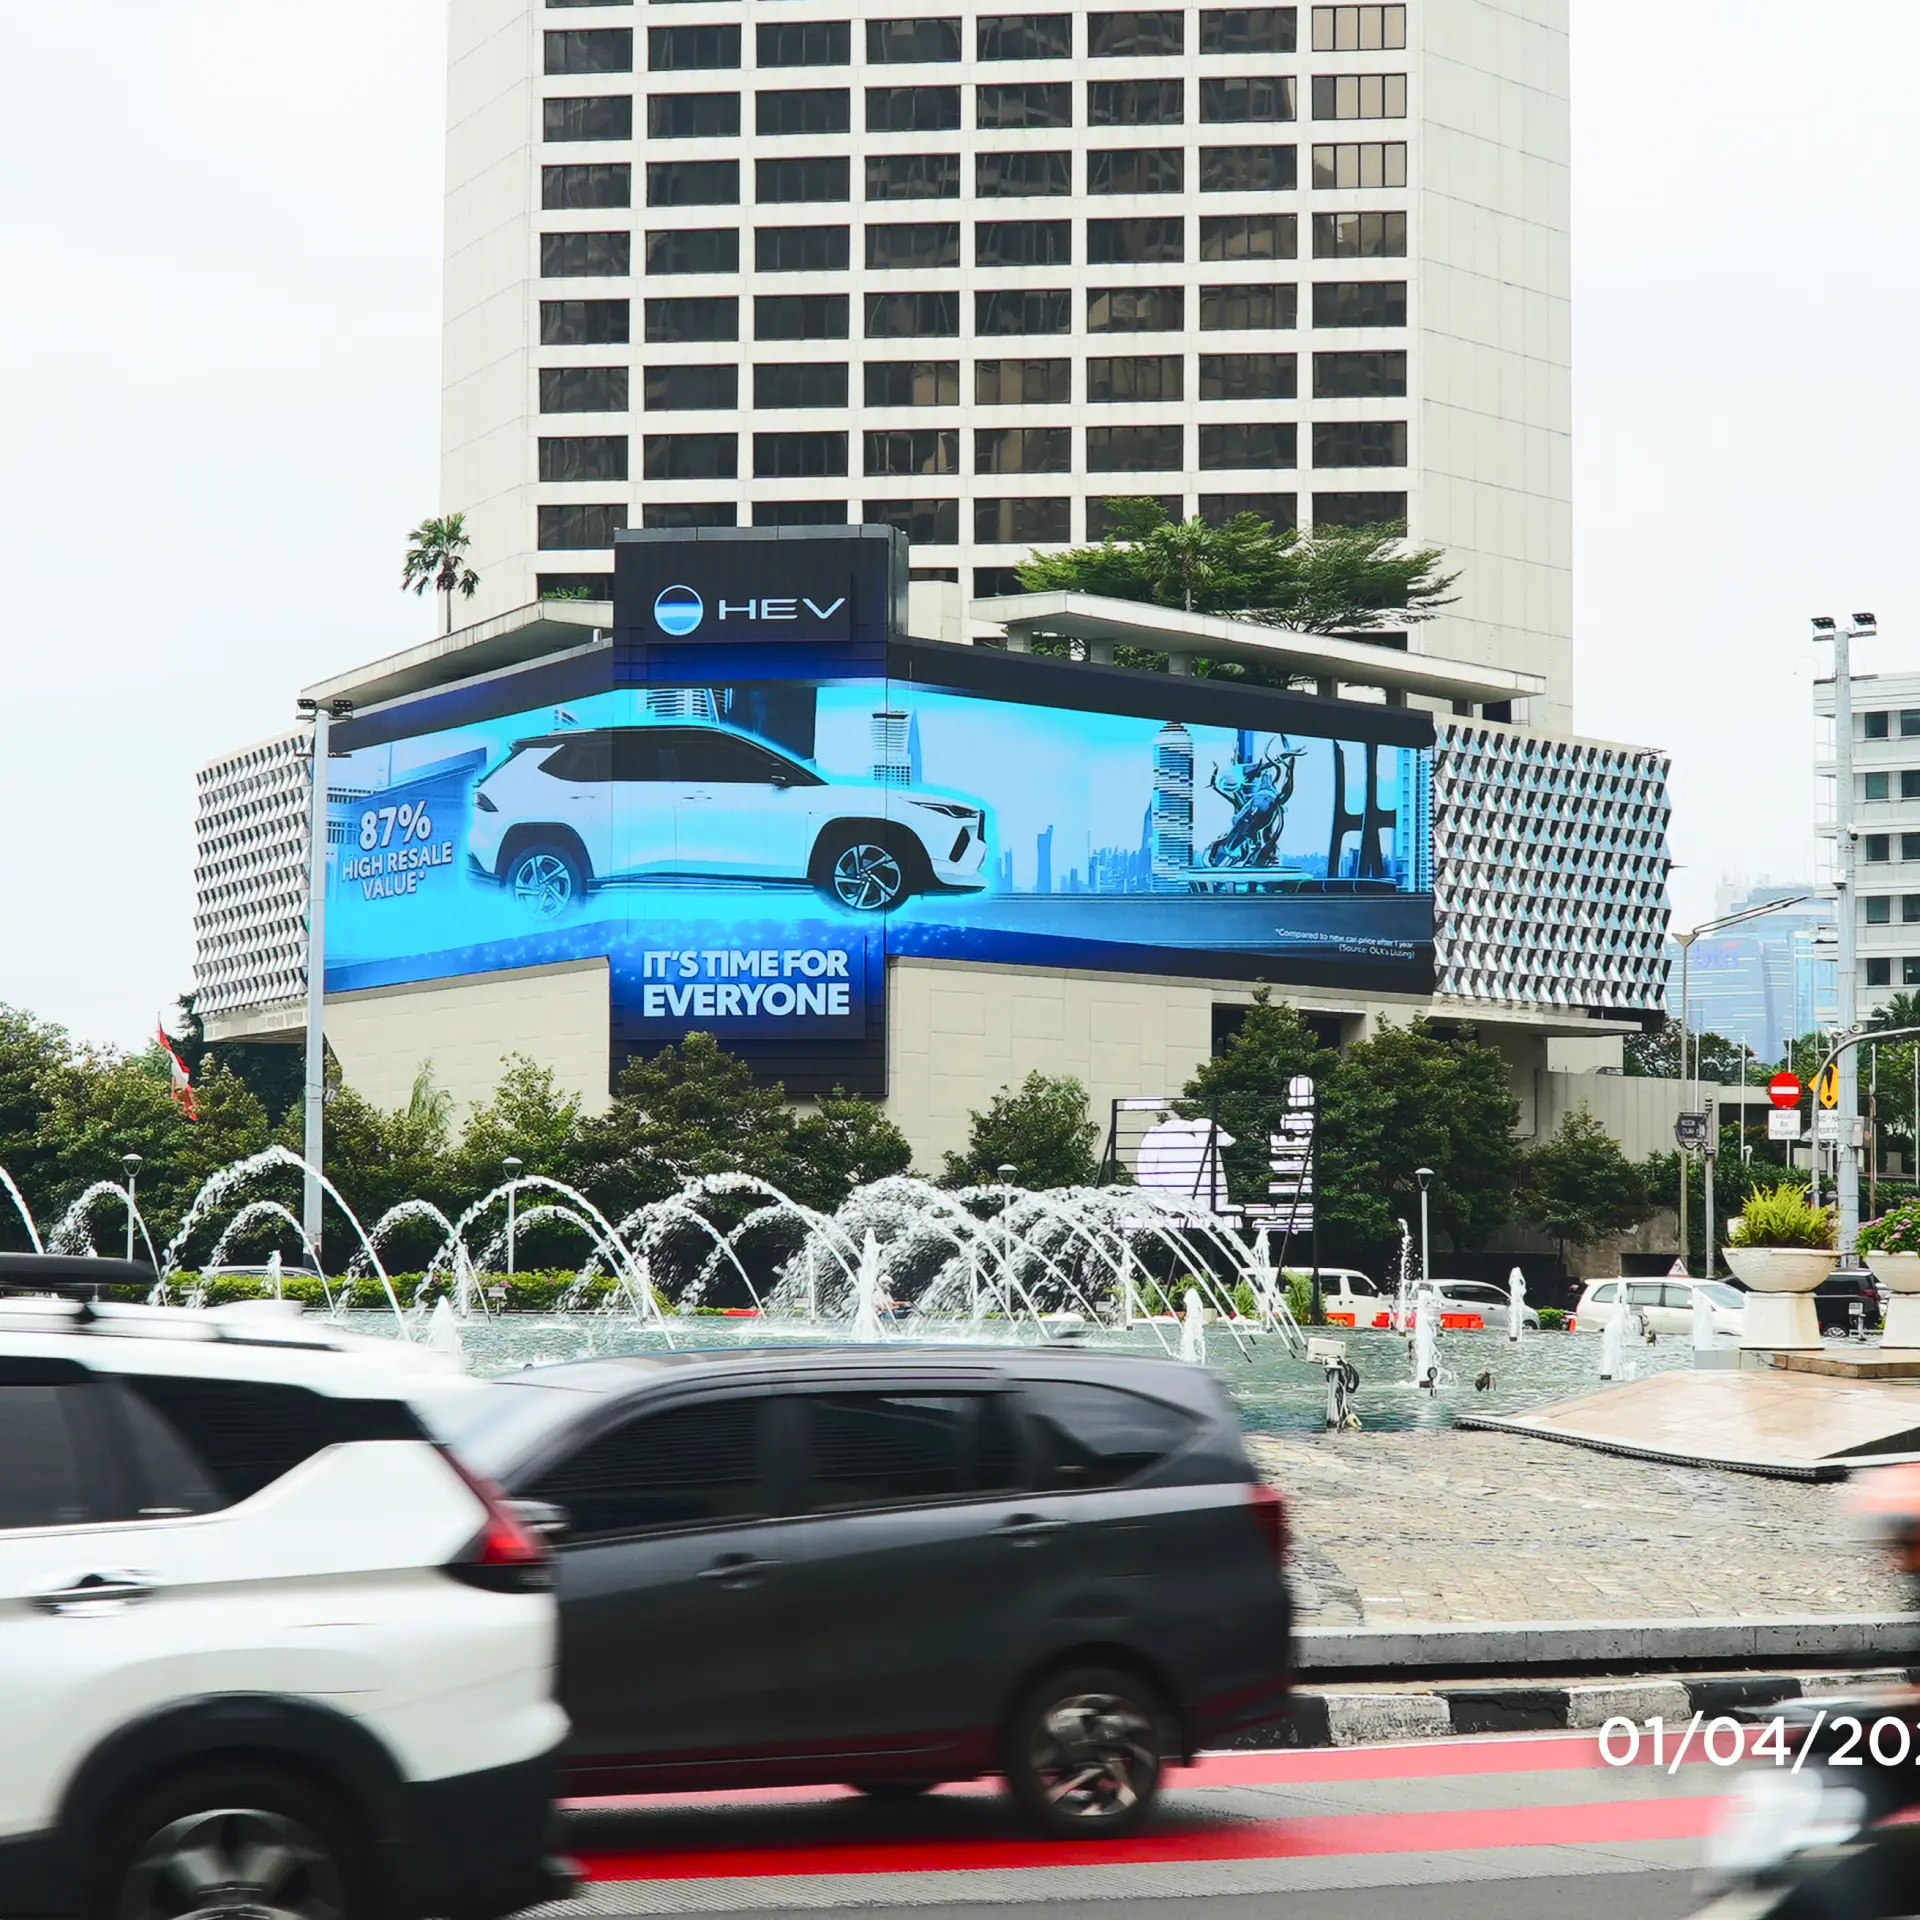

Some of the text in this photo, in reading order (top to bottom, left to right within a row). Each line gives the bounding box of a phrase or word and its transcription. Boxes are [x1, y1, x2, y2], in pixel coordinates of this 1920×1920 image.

[718, 597, 846, 621] HEV
[360, 799, 432, 851] 87%
[342, 841, 453, 881] HIGH RESALE
[1319, 932, 1329, 941] to
[1329, 934, 1345, 943] new
[1346, 935, 1358, 944] car
[1358, 936, 1377, 946] price
[643, 949, 849, 978] IT'S TIME FOR
[643, 982, 850, 1018] EVERYONE
